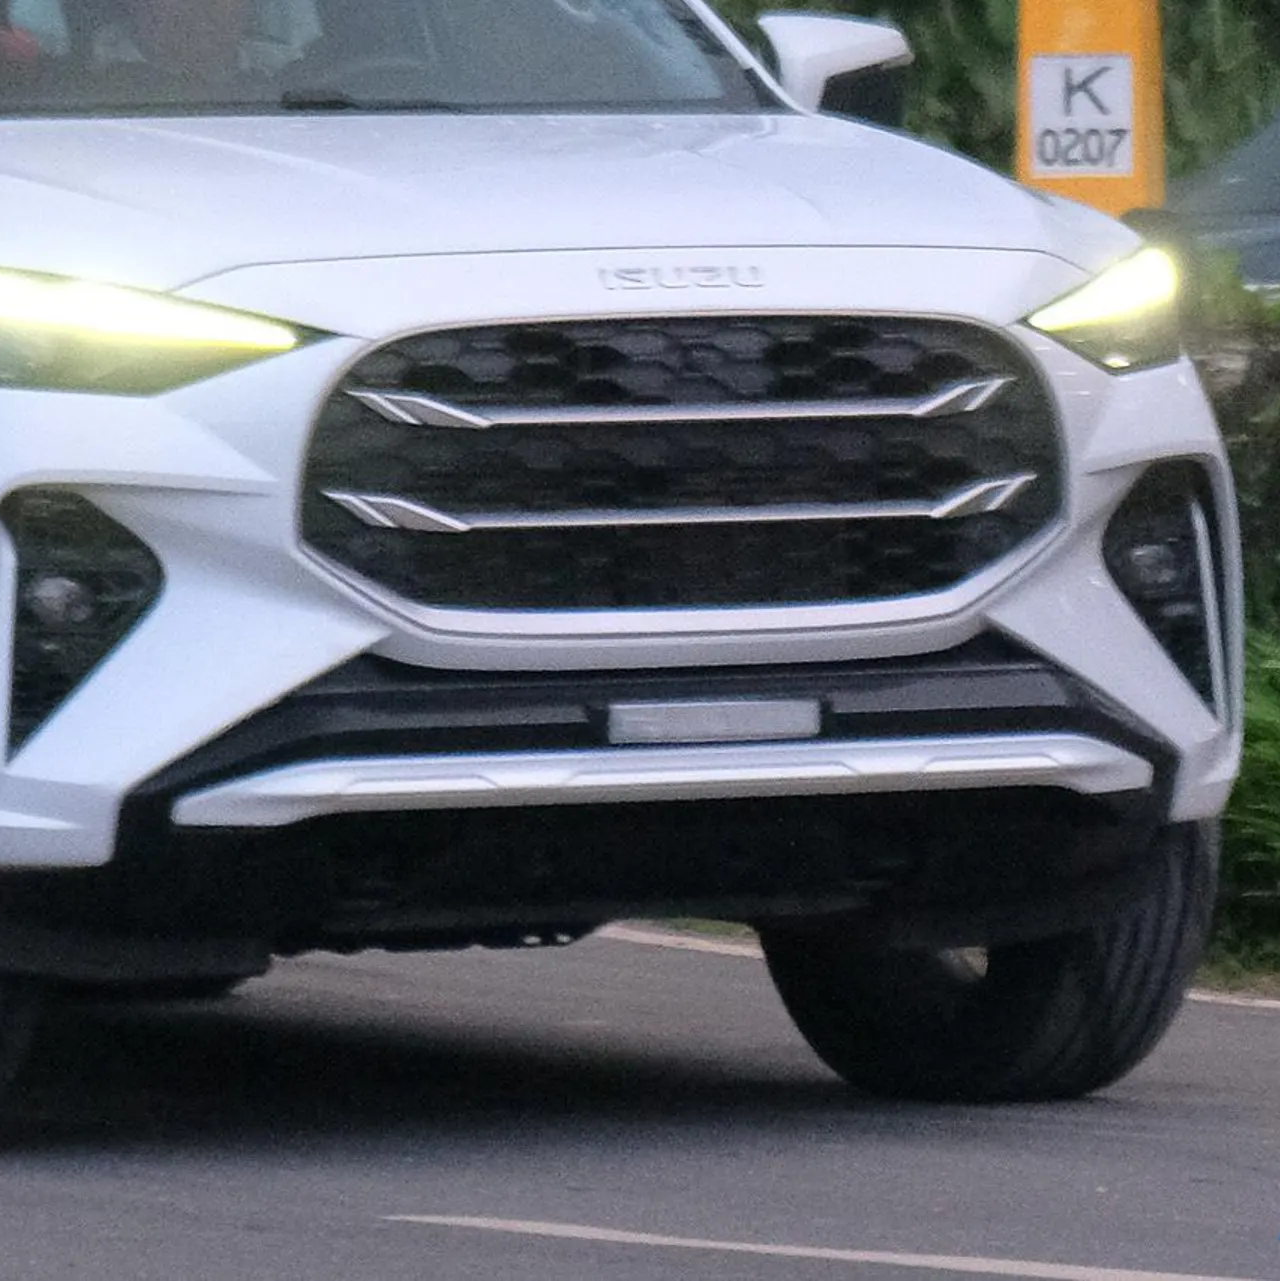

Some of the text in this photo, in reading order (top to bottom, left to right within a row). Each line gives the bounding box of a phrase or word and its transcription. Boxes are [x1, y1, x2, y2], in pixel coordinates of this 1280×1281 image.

[1063, 65, 1114, 117] K
[1038, 127, 1130, 167] 0207
[595, 265, 766, 290] ISUZU
